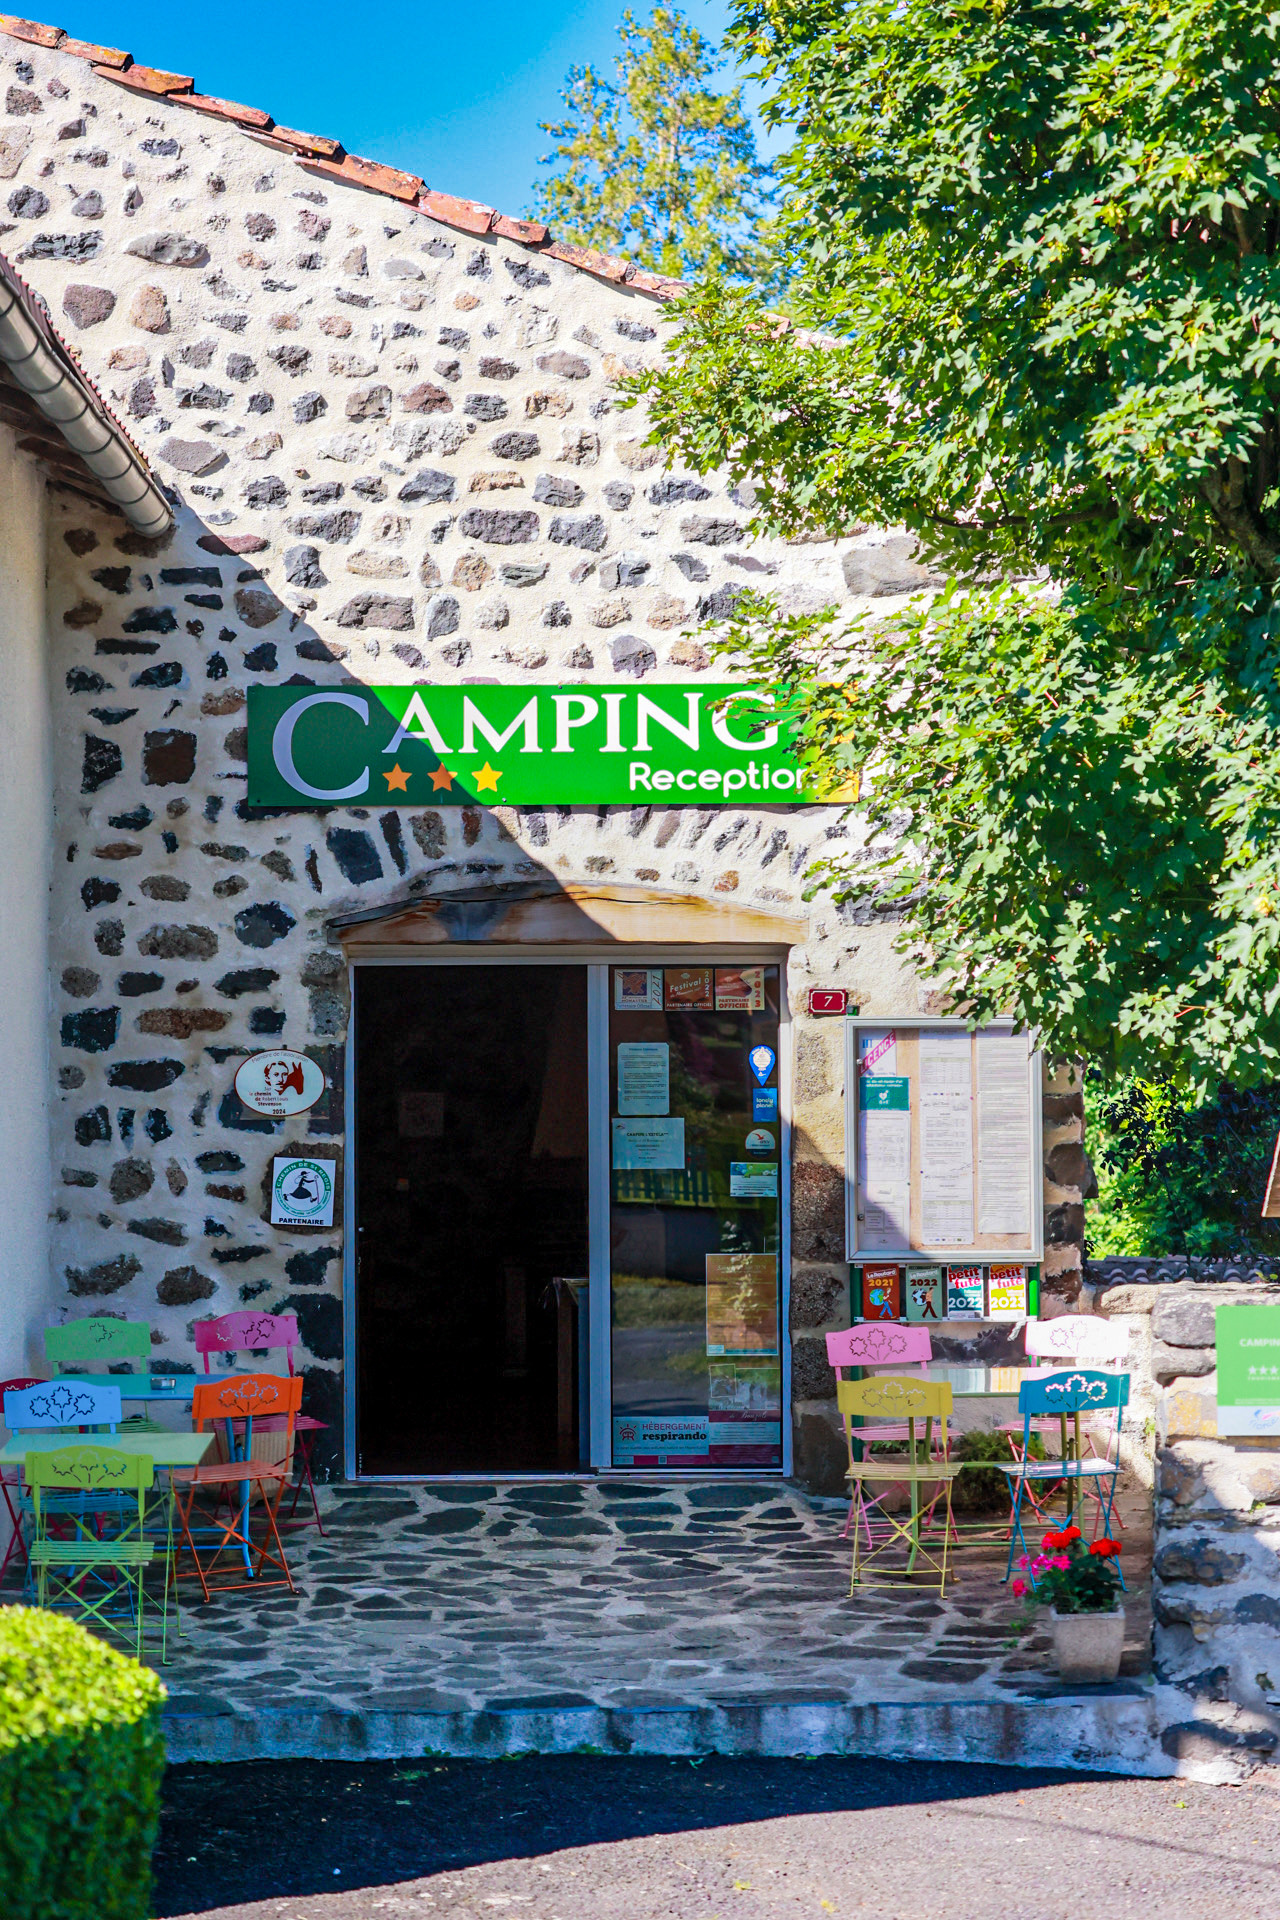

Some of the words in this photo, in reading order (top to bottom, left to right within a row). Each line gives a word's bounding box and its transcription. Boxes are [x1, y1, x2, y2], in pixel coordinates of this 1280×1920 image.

[272, 690, 778, 801] CAMPING
[670, 977, 702, 993] Festival
[824, 995, 834, 1008] 7
[860, 1031, 896, 1074] LICENCE
[278, 1217, 324, 1225] PARTENAIRE
[948, 1266, 980, 1283] petit
[990, 1266, 1022, 1283] petit
[868, 1278, 894, 1287] 2021
[910, 1278, 938, 1287] 2022
[954, 1276, 981, 1289] futé
[997, 1276, 1023, 1289] futé
[948, 1297, 982, 1308] 2022
[990, 1296, 1025, 1308] 2023
[642, 1420, 706, 1431] HÉBERGEMENT
[642, 1431, 707, 1442] respirando
